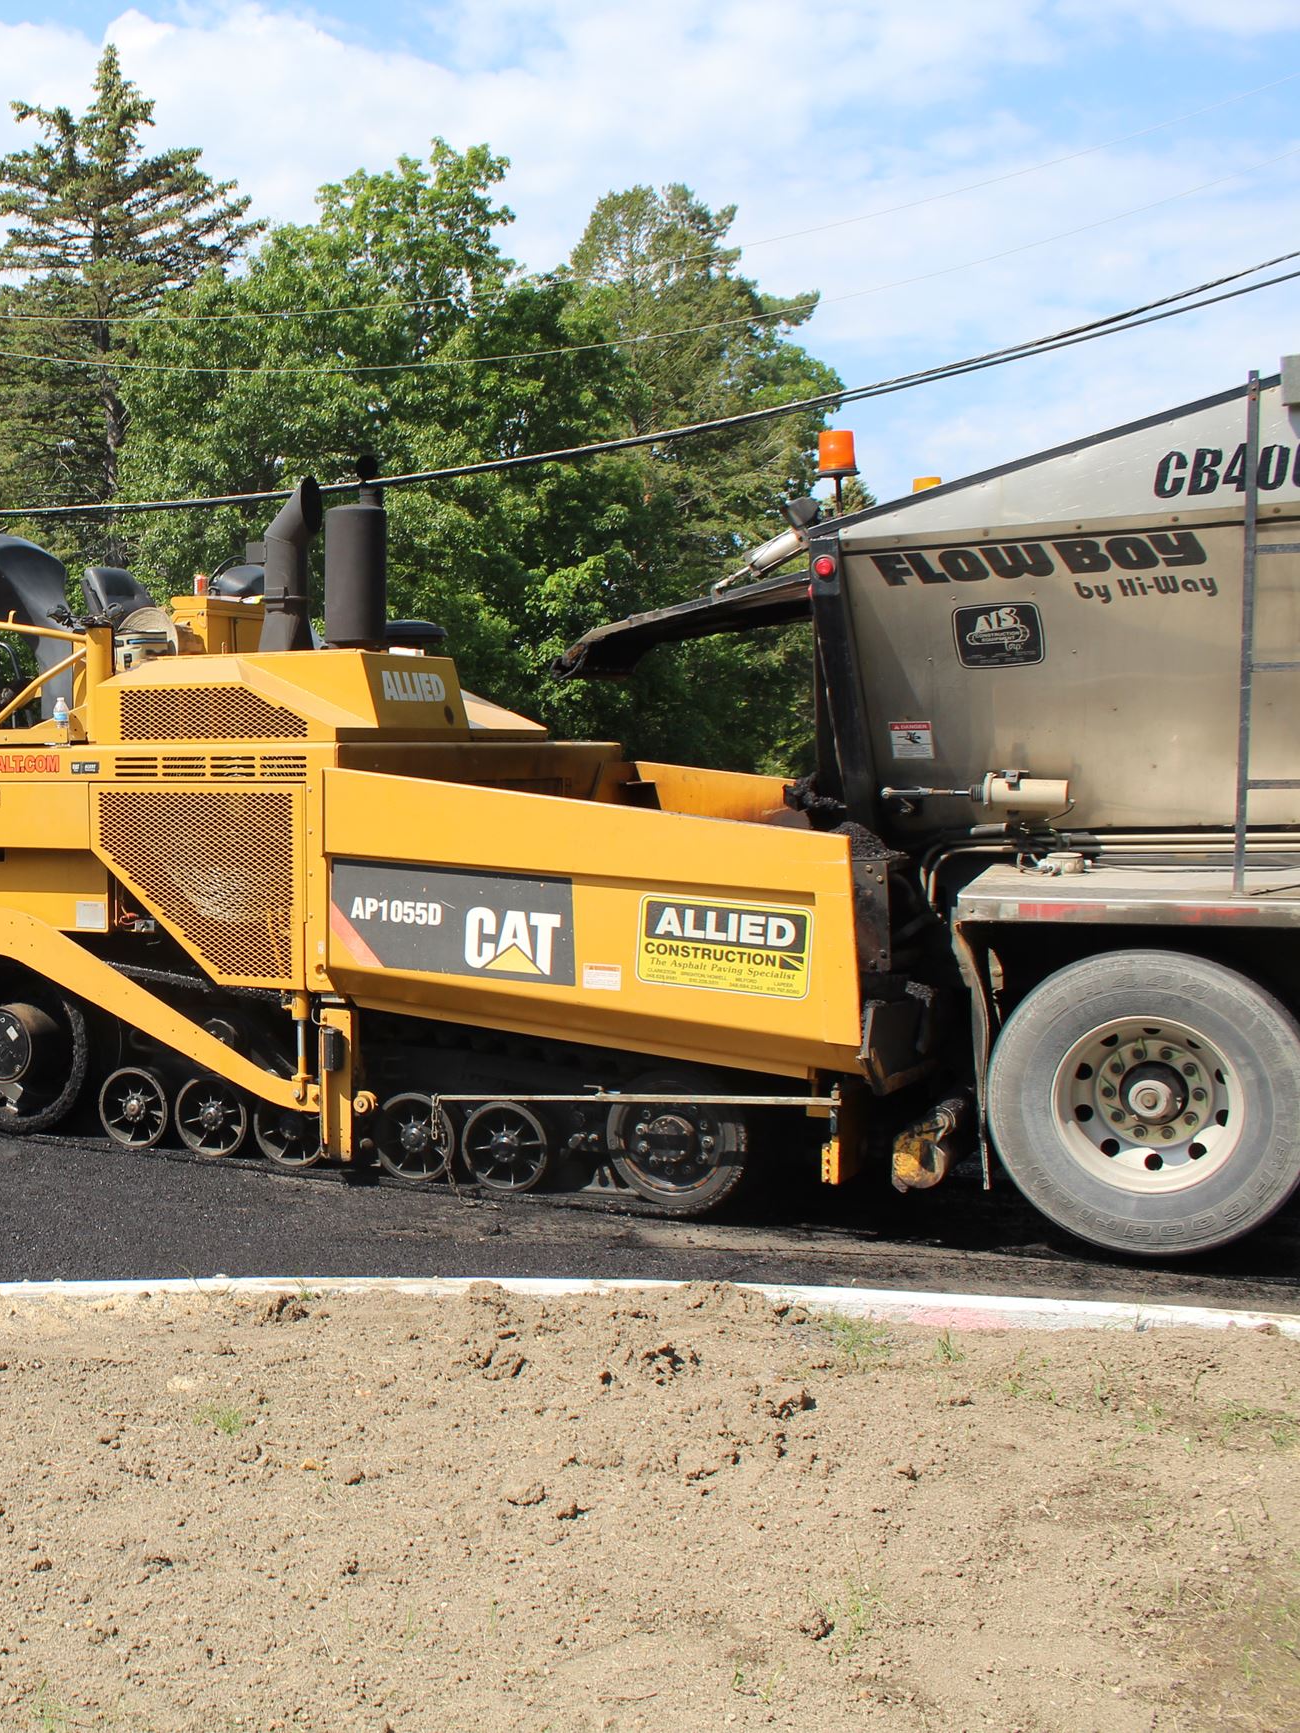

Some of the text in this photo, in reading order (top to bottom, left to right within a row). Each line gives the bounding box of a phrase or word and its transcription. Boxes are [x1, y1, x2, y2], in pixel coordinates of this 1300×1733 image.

[1153, 443, 1300, 499] CB40
[870, 531, 1208, 587] FLOW BOY
[1074, 575, 1219, 604] by Hi-Way
[974, 607, 1020, 633] AIS
[381, 670, 446, 702] ALLIED
[350, 896, 442, 926] AP1055D
[464, 906, 561, 976] CAT
[654, 906, 797, 948] ALLIED
[644, 942, 777, 967] CONSTRUCTION
[650, 957, 797, 981] The Asphalt Paving Specialist
